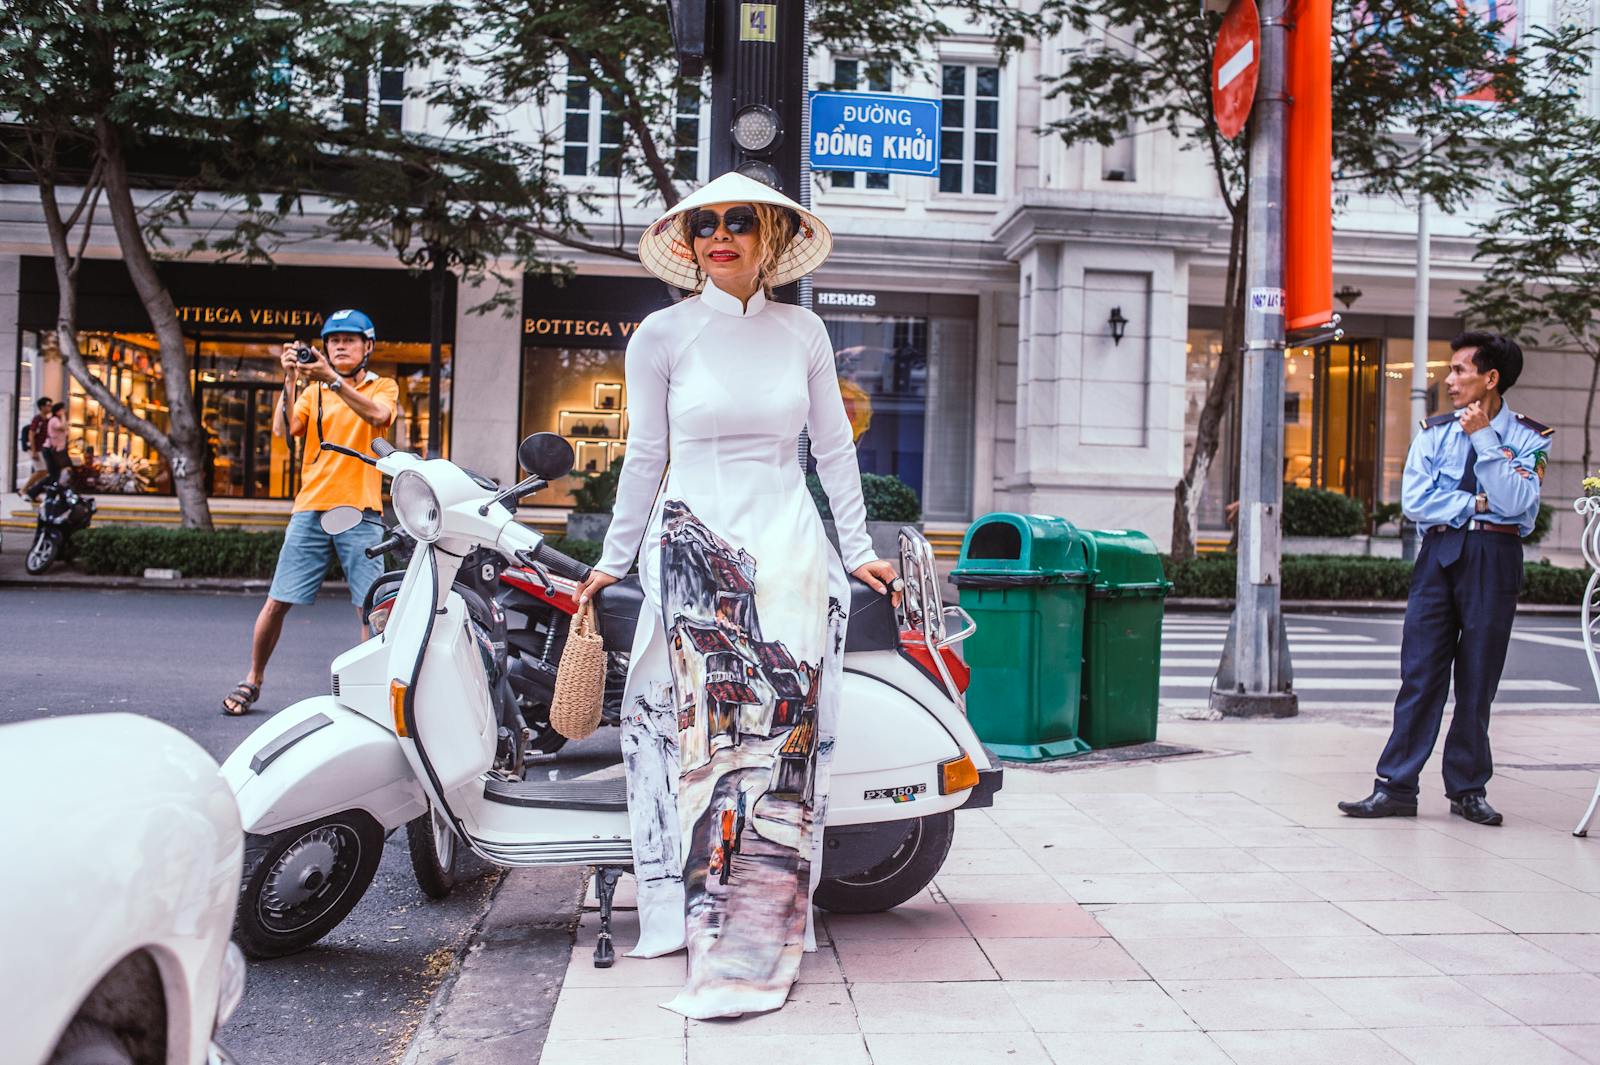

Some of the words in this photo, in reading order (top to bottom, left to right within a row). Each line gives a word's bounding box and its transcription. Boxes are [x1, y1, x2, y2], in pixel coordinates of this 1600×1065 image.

[751, 11, 767, 34] 4
[843, 104, 912, 126] ĐƯỜNG
[815, 123, 873, 158] ĐỒNG
[882, 127, 933, 162] KHỞI
[175, 307, 242, 323] TTEGA
[250, 309, 323, 325] VENETA
[524, 318, 613, 336] BOTTEGA
[866, 789, 888, 800] PX
[892, 786, 914, 797] 150
[917, 784, 926, 794] E
